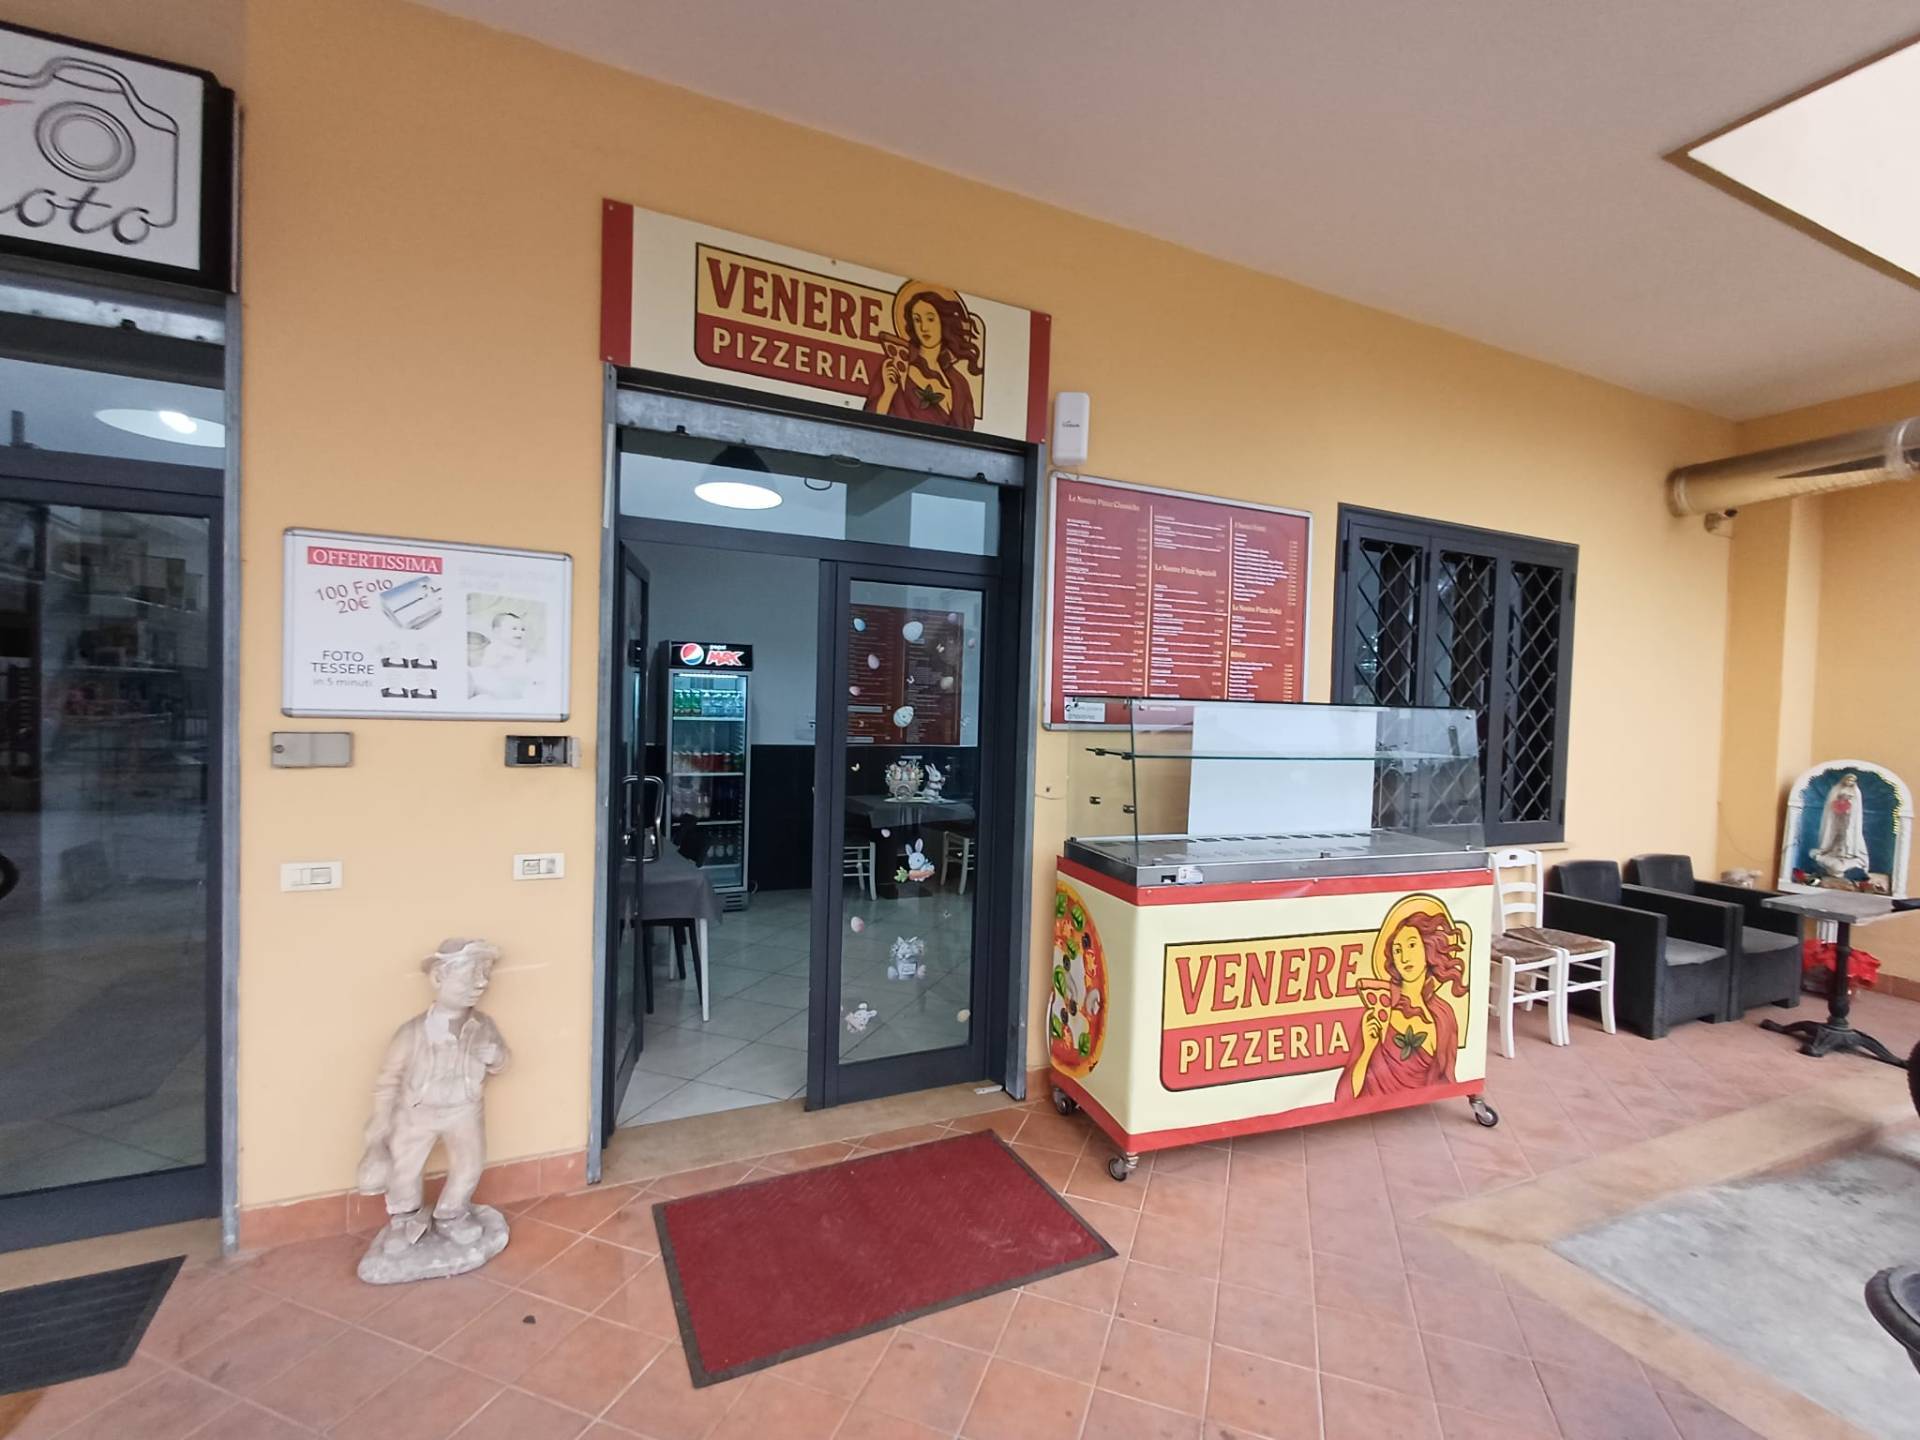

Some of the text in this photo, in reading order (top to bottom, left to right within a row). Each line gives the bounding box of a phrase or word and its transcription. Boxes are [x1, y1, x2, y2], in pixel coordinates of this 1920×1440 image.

[0, 186, 150, 245] oto
[706, 256, 883, 343] VENERE
[712, 326, 870, 386] PIZZERIA
[312, 549, 439, 573] OFFERTISSIMA
[315, 584, 348, 601] 100
[336, 596, 370, 614] 20€
[311, 662, 376, 675] TESSERE
[322, 650, 365, 663] FOTO
[705, 650, 745, 667] MAX
[1175, 943, 1364, 1016] VENERE
[1178, 1021, 1351, 1076] PIZZERIA
